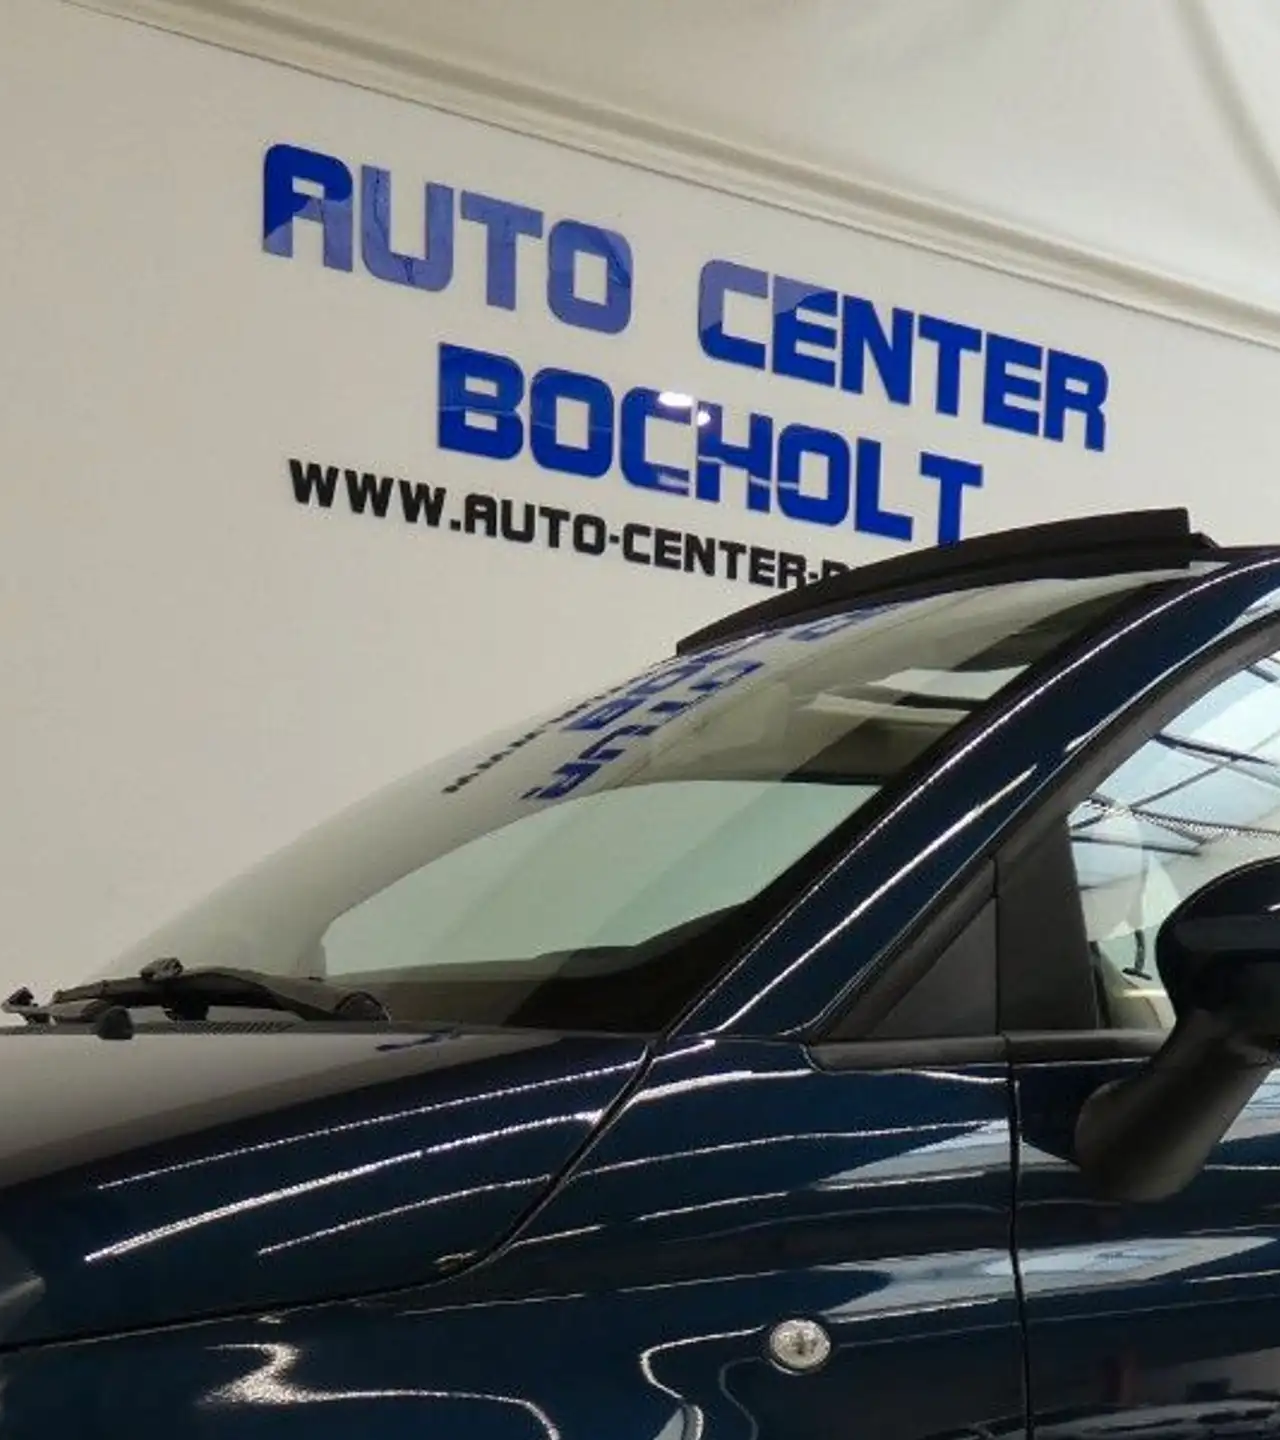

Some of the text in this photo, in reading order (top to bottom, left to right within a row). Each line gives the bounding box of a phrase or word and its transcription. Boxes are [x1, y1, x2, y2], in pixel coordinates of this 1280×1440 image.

[263, 142, 1111, 453] AUTO CENTER
[437, 342, 985, 547] BOCHOLT
